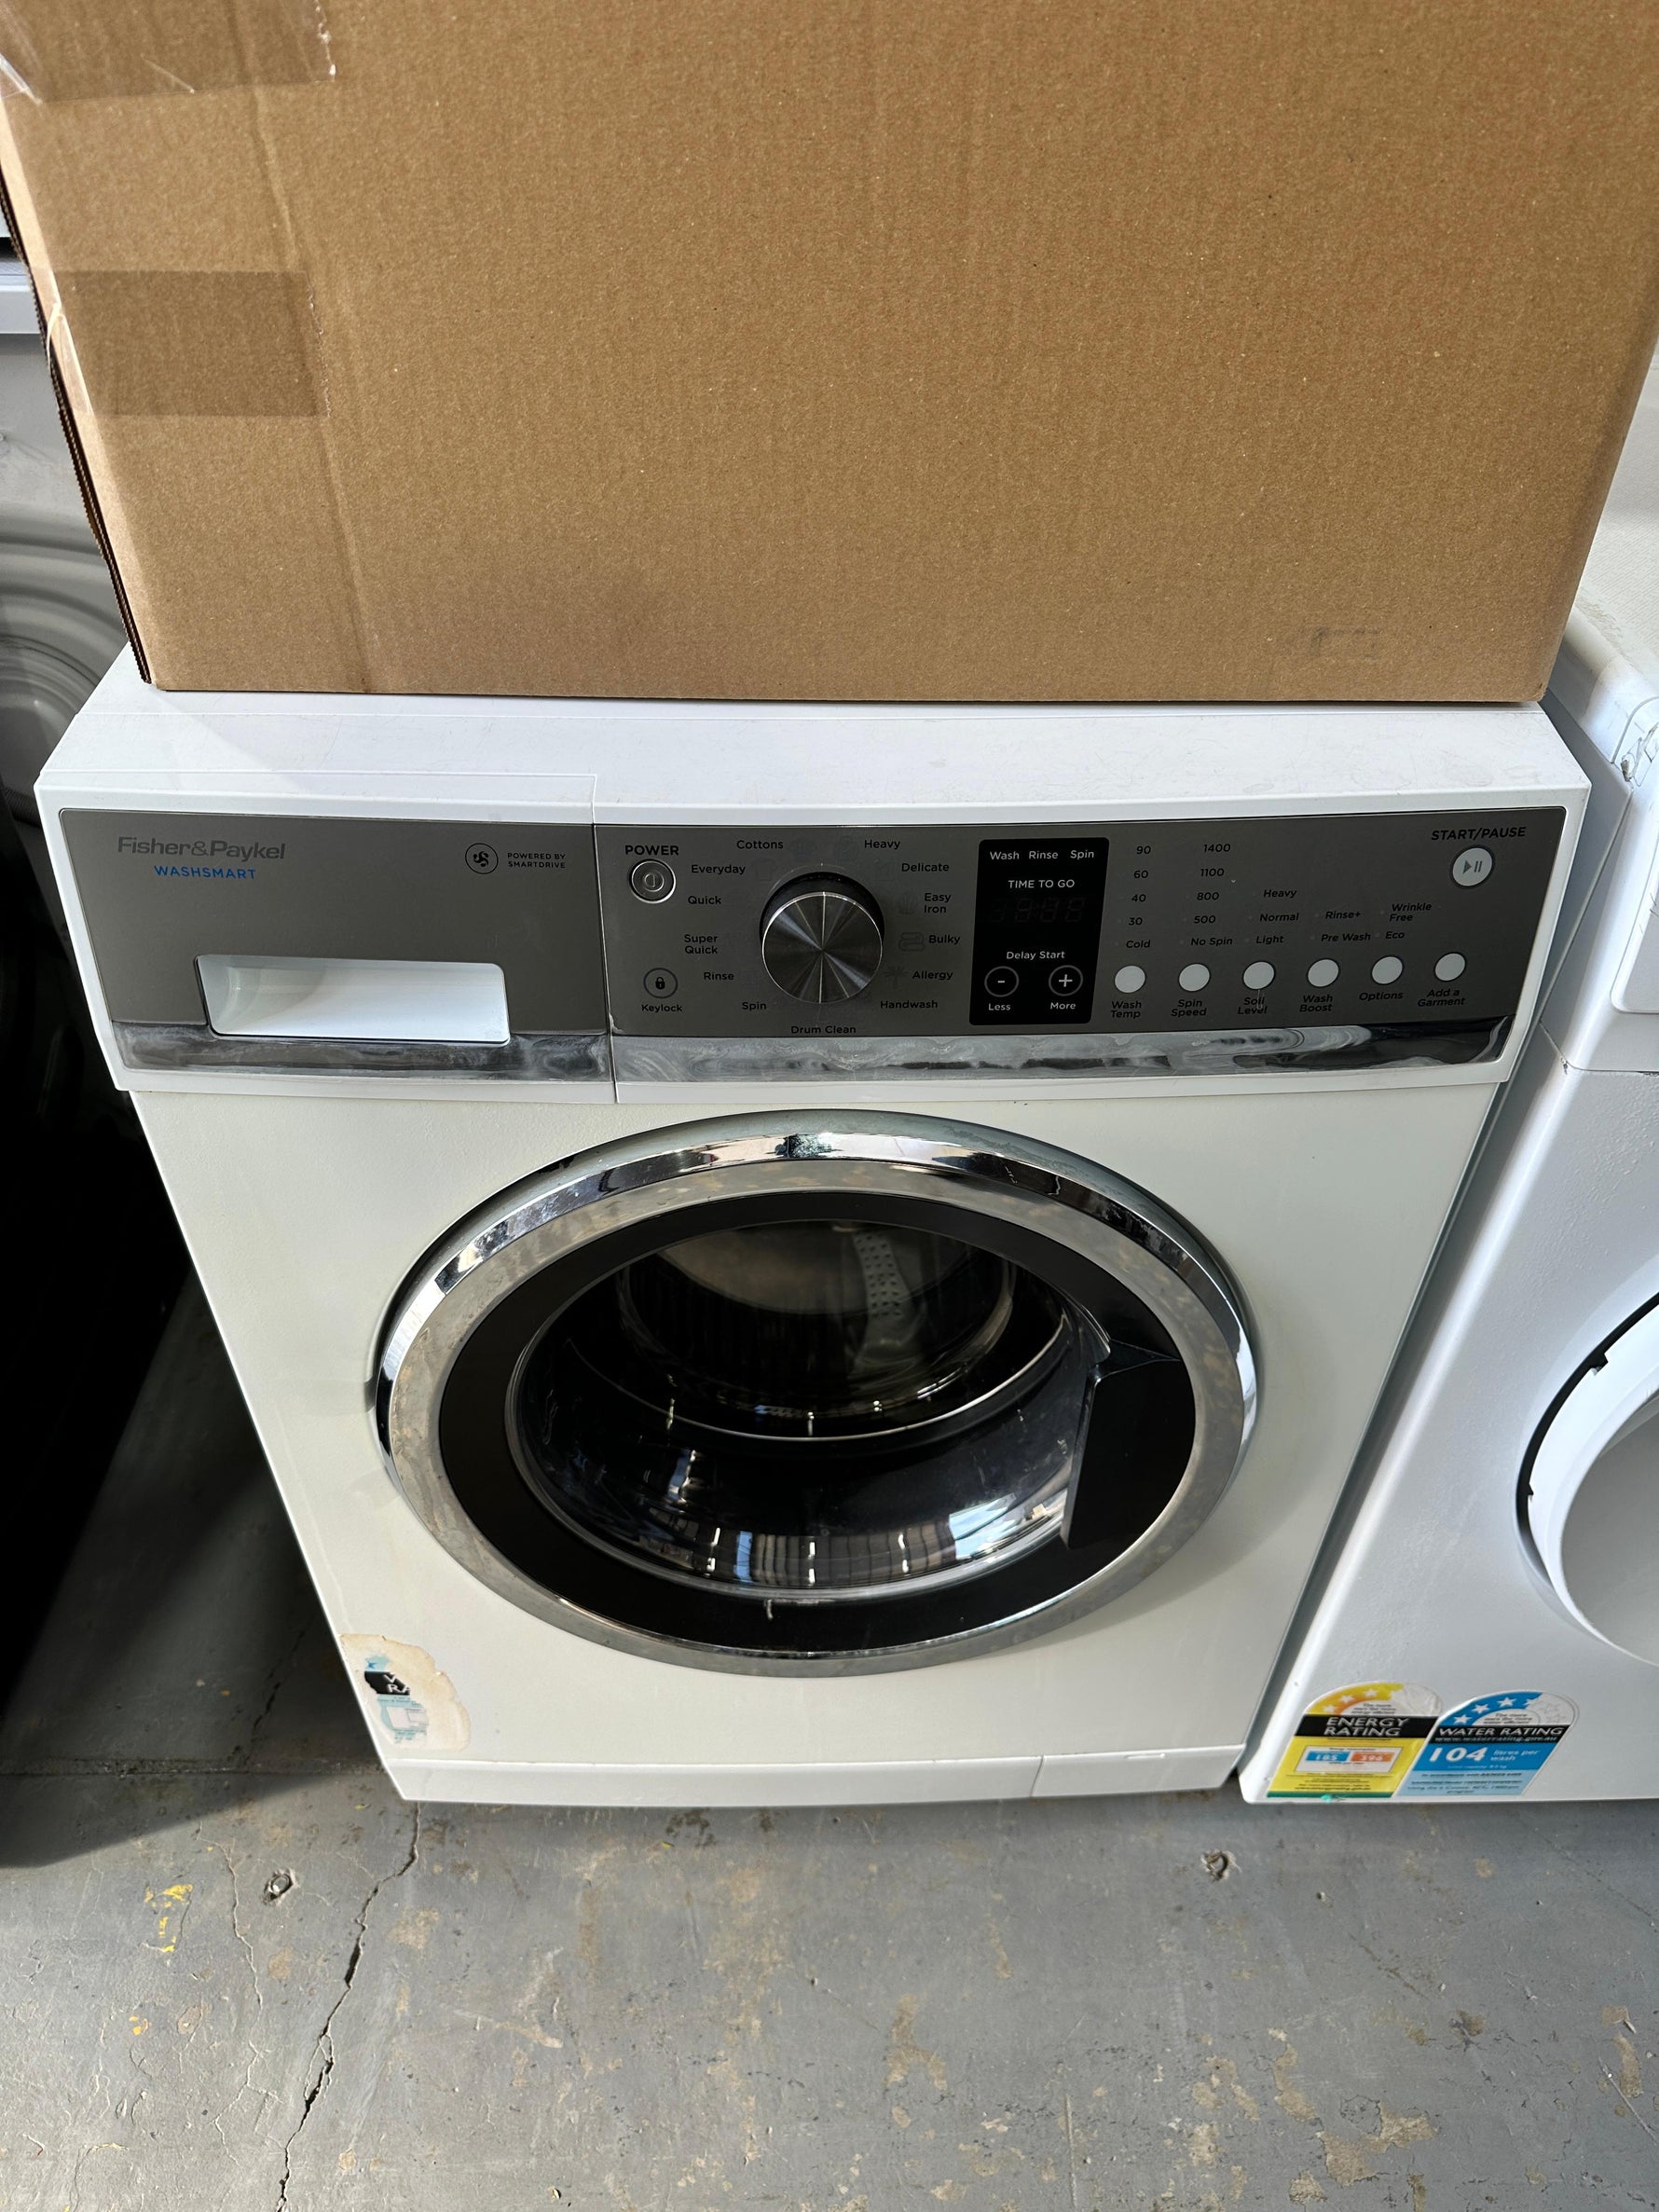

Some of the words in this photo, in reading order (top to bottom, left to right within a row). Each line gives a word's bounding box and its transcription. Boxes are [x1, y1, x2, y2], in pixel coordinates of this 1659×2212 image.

[1431, 827, 1527, 841] START/PAUSE
[118, 836, 285, 862] Fisher&Paykel
[736, 840, 784, 850] Cottons
[864, 840, 900, 850] Heavy
[1136, 845, 1151, 855] 90
[1203, 844, 1231, 853] 1400
[624, 845, 679, 856] POWER
[990, 851, 1020, 860] Wash
[1029, 850, 1059, 859] Rinse
[1070, 849, 1094, 859] Spin
[154, 865, 256, 879] WASHSMART
[691, 864, 746, 875] Everyday
[901, 862, 950, 872] Delicate
[1133, 870, 1148, 879] 60
[1200, 868, 1225, 877] 1100
[1008, 880, 1035, 888] TIME
[1039, 880, 1054, 888] TO
[1057, 879, 1075, 887] GO
[924, 893, 952, 903] Easy
[1131, 894, 1146, 902] 40
[1197, 892, 1219, 900] 800
[1263, 889, 1296, 899] Heavy
[688, 896, 721, 906] Quick
[924, 904, 947, 914] Iron
[1392, 902, 1432, 913] Wrinkle
[1194, 914, 1216, 924] 500
[1259, 913, 1299, 922] Normal
[1325, 910, 1361, 919] Rinse+
[1390, 913, 1413, 922] Free
[1128, 917, 1143, 926] 30
[684, 934, 718, 945] Super
[928, 934, 960, 945] Bulky
[1255, 935, 1284, 945] Light
[1321, 934, 1339, 942] Pre
[1342, 932, 1371, 941] Wash
[1385, 931, 1405, 940] Eco
[1126, 940, 1151, 949] Cold
[1190, 938, 1207, 946] No
[1209, 937, 1233, 946] Spin
[684, 945, 718, 955] Quick
[1007, 951, 1036, 960] Delay
[1039, 950, 1065, 959] Start
[704, 971, 734, 981] Rinse
[912, 969, 953, 981] Allergy
[1359, 991, 1404, 1002] Options
[1427, 988, 1449, 997] Add
[880, 1000, 938, 1009] Handwash
[1178, 999, 1202, 1009] Spin
[1243, 996, 1265, 1006] Soil
[1303, 995, 1333, 1004] Wash
[1418, 996, 1466, 1008] Garment
[641, 1003, 682, 1013] Keylock
[742, 1001, 766, 1011] Spin
[988, 1003, 1011, 1011] Less
[1050, 1002, 1076, 1010] More
[1111, 1000, 1142, 1010] Wash
[1299, 1003, 1332, 1012] Boost
[1111, 1010, 1141, 1019] Temp
[1171, 1008, 1207, 1018] Speed
[1238, 1006, 1268, 1015] Level
[790, 1025, 821, 1034] Drum
[826, 1025, 857, 1034] Clean
[1326, 1717, 1409, 1726] ENERGY
[1323, 1727, 1402, 1737] RATING
[1501, 1727, 1564, 1736] RATING
[1429, 1747, 1488, 1762] 104
